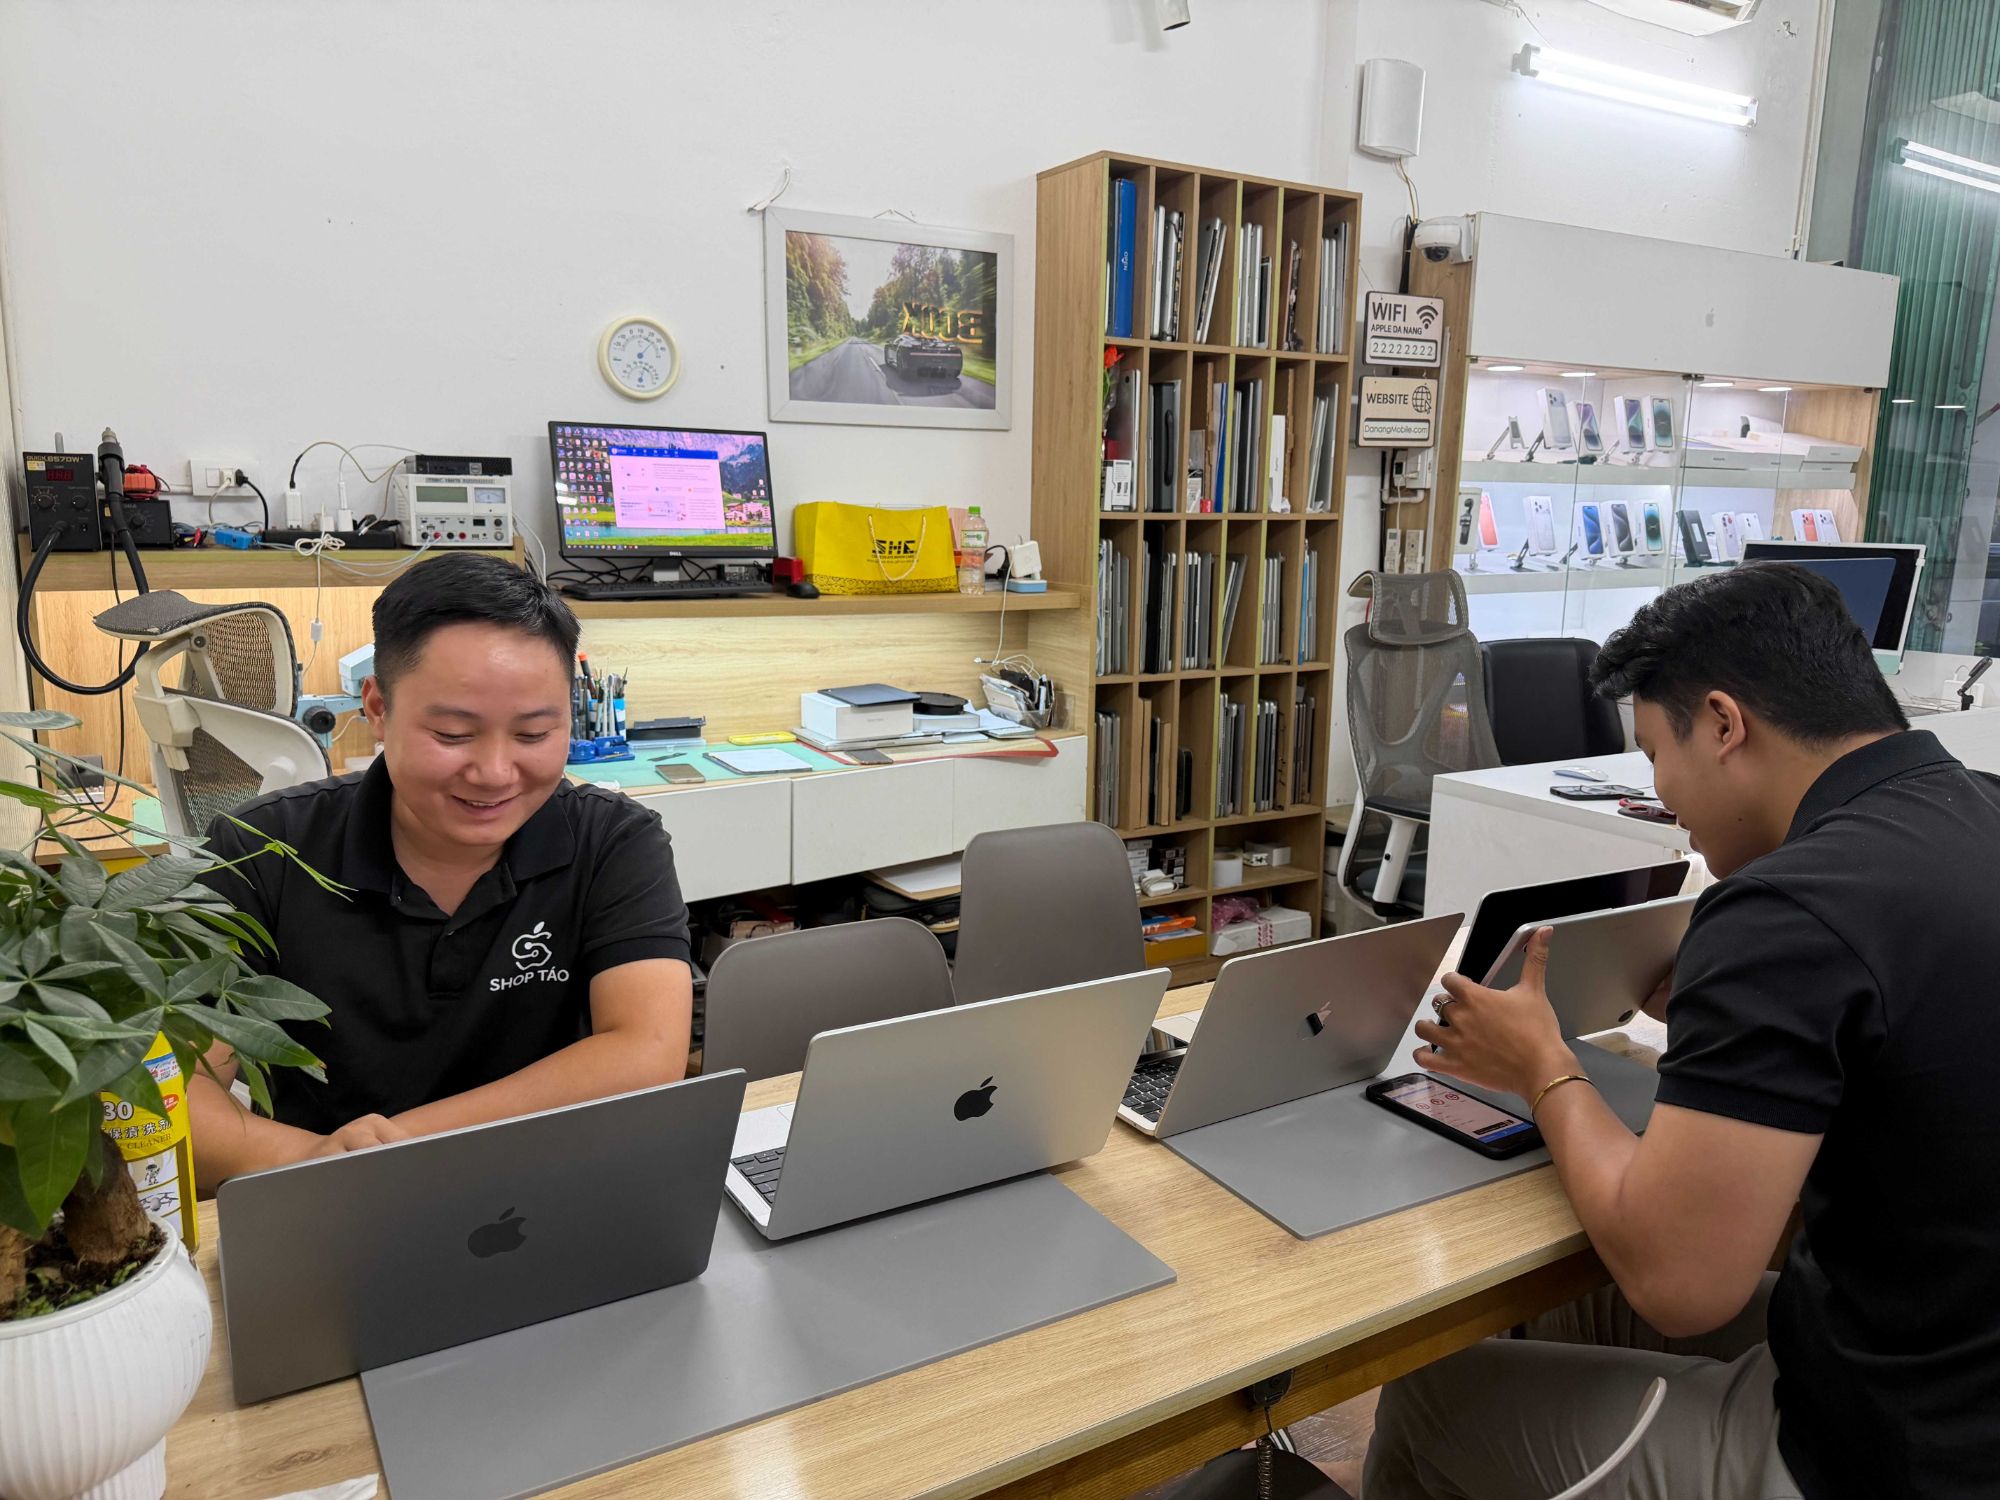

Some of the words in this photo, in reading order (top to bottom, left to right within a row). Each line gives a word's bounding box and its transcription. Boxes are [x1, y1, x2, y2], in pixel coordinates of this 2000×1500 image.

[1372, 301, 1407, 322] WIFI
[1371, 323, 1393, 333] APPLE
[1393, 325, 1402, 334] DA
[1403, 326, 1423, 335] NANG
[1373, 342, 1434, 357] 22222222
[1366, 393, 1409, 405] WEBSITE
[1364, 424, 1428, 435] DanangMobile.com
[872, 539, 916, 554] SHE
[489, 971, 535, 991] SHOP
[537, 966, 570, 982] TÁO
[102, 1119, 171, 1139] 保清洗剂
[127, 1133, 171, 1150] CLEANER
